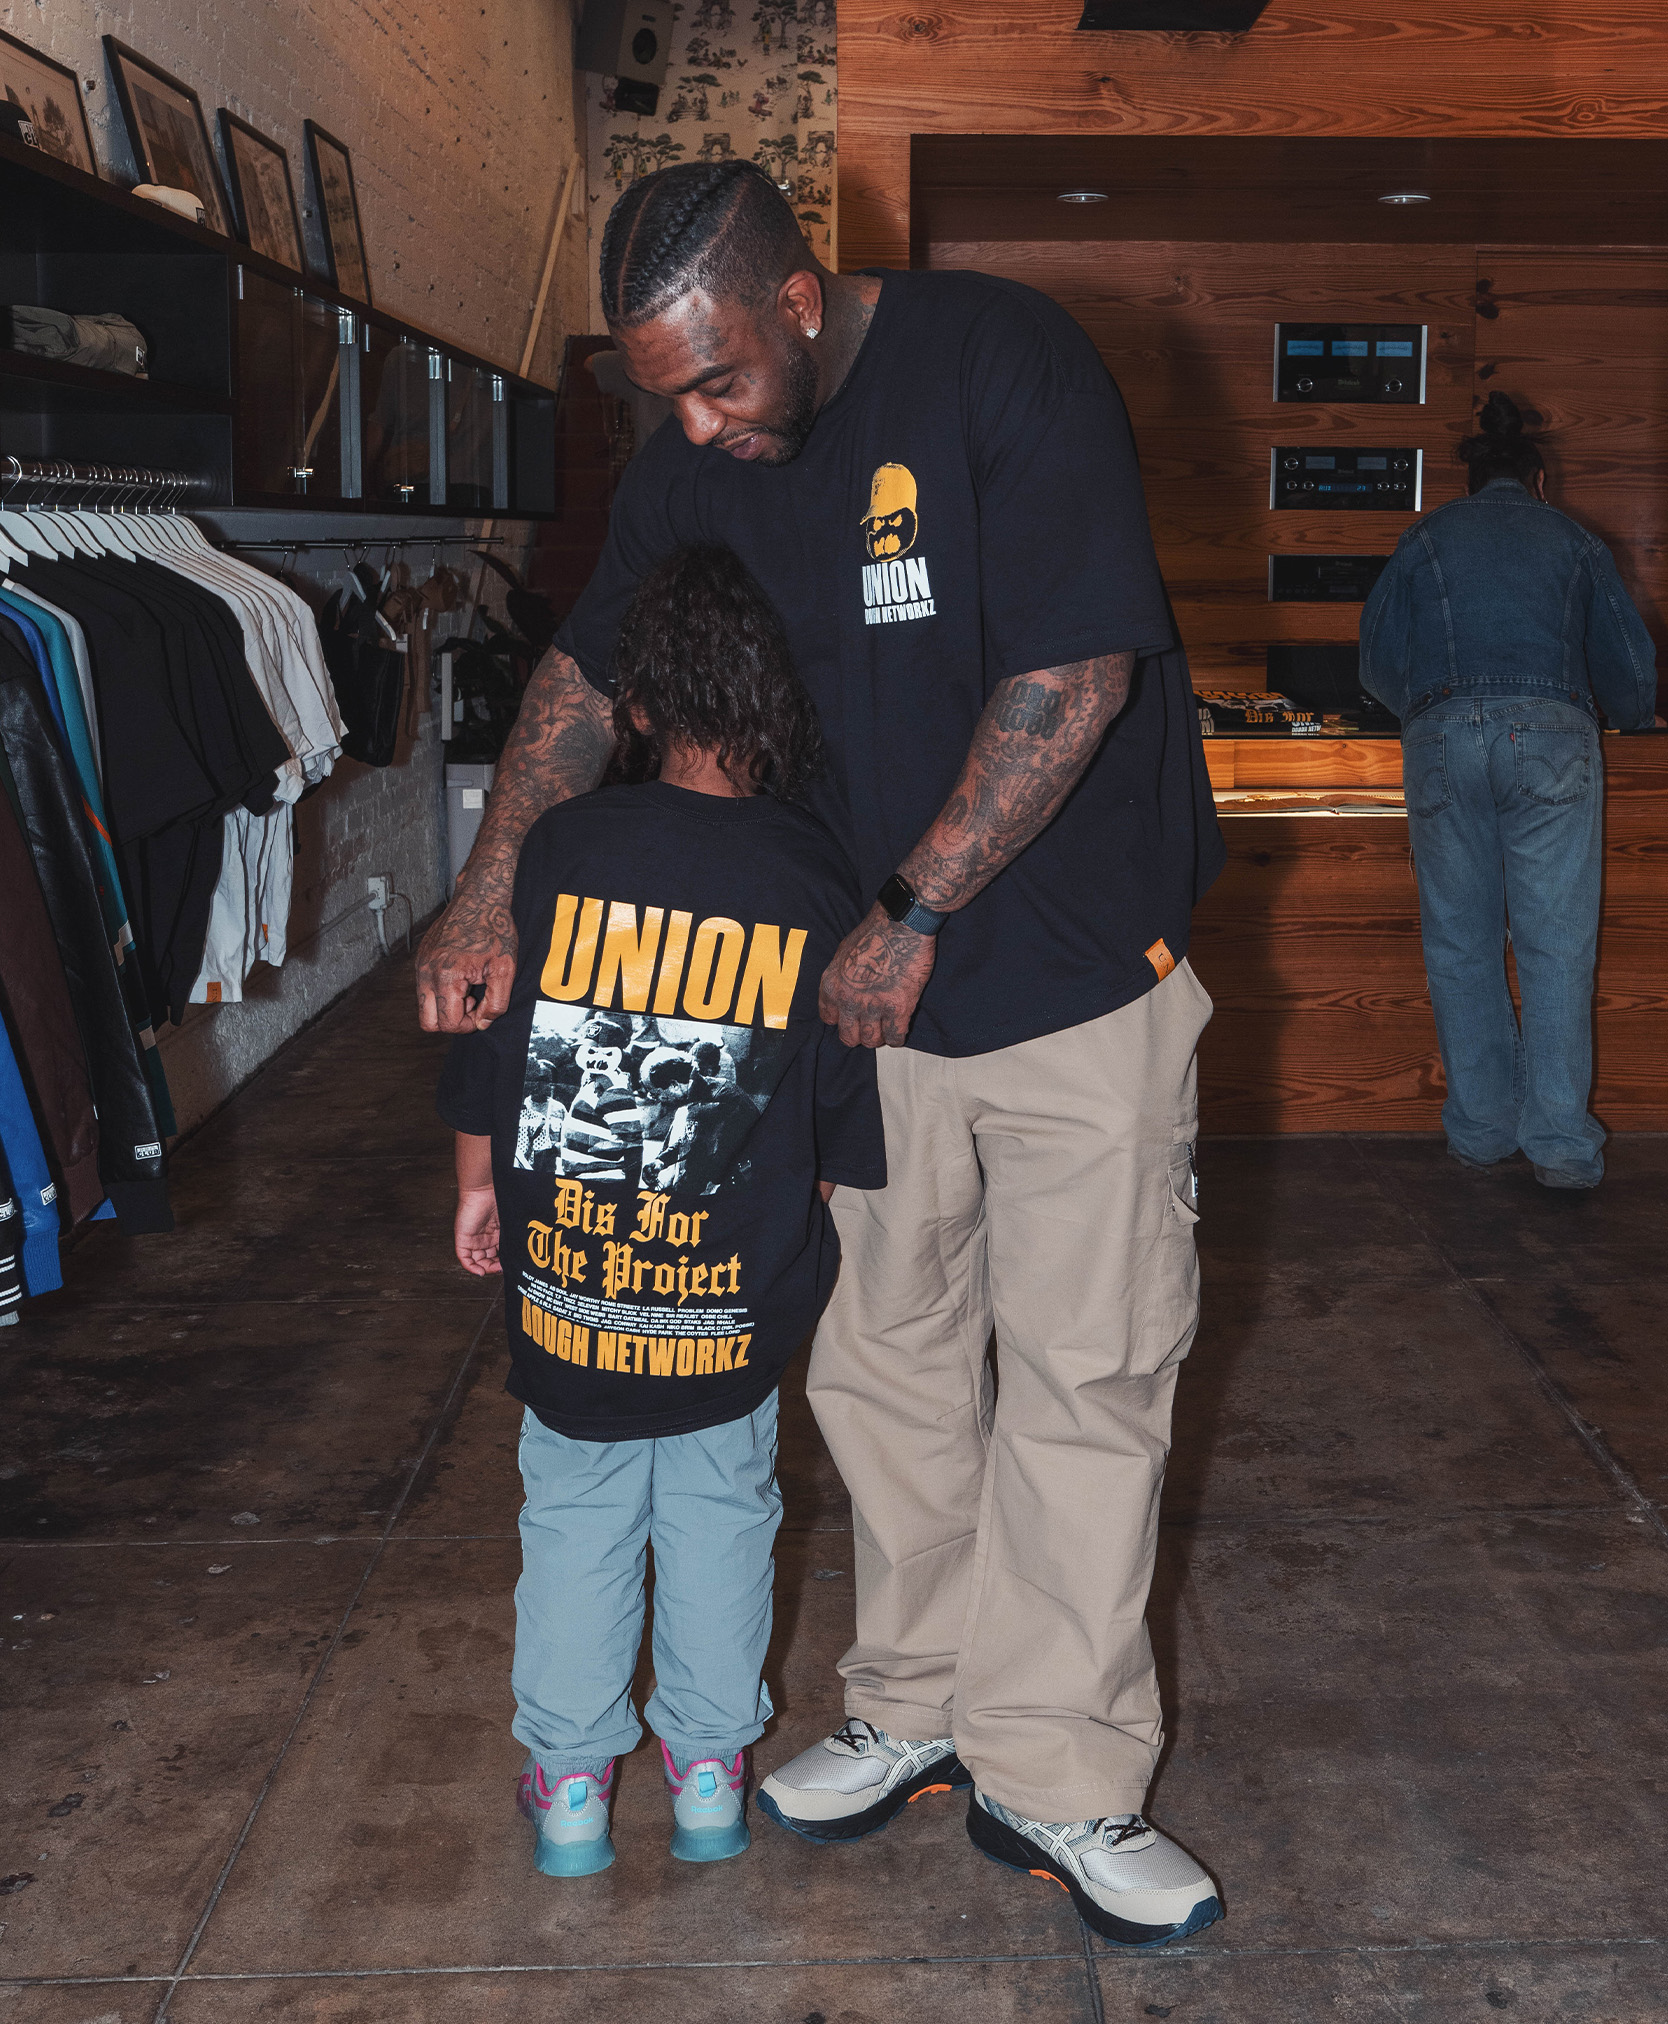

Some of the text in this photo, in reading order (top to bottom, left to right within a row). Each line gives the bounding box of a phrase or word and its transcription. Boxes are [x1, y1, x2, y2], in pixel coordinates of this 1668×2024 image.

[862, 557, 931, 607] UNION
[881, 599, 937, 623] NETWORKZ
[540, 893, 809, 1030] UNION
[554, 1177, 710, 1248] Dis For
[527, 1219, 742, 1307] The Project
[596, 1333, 752, 1377] NETWORKZ
